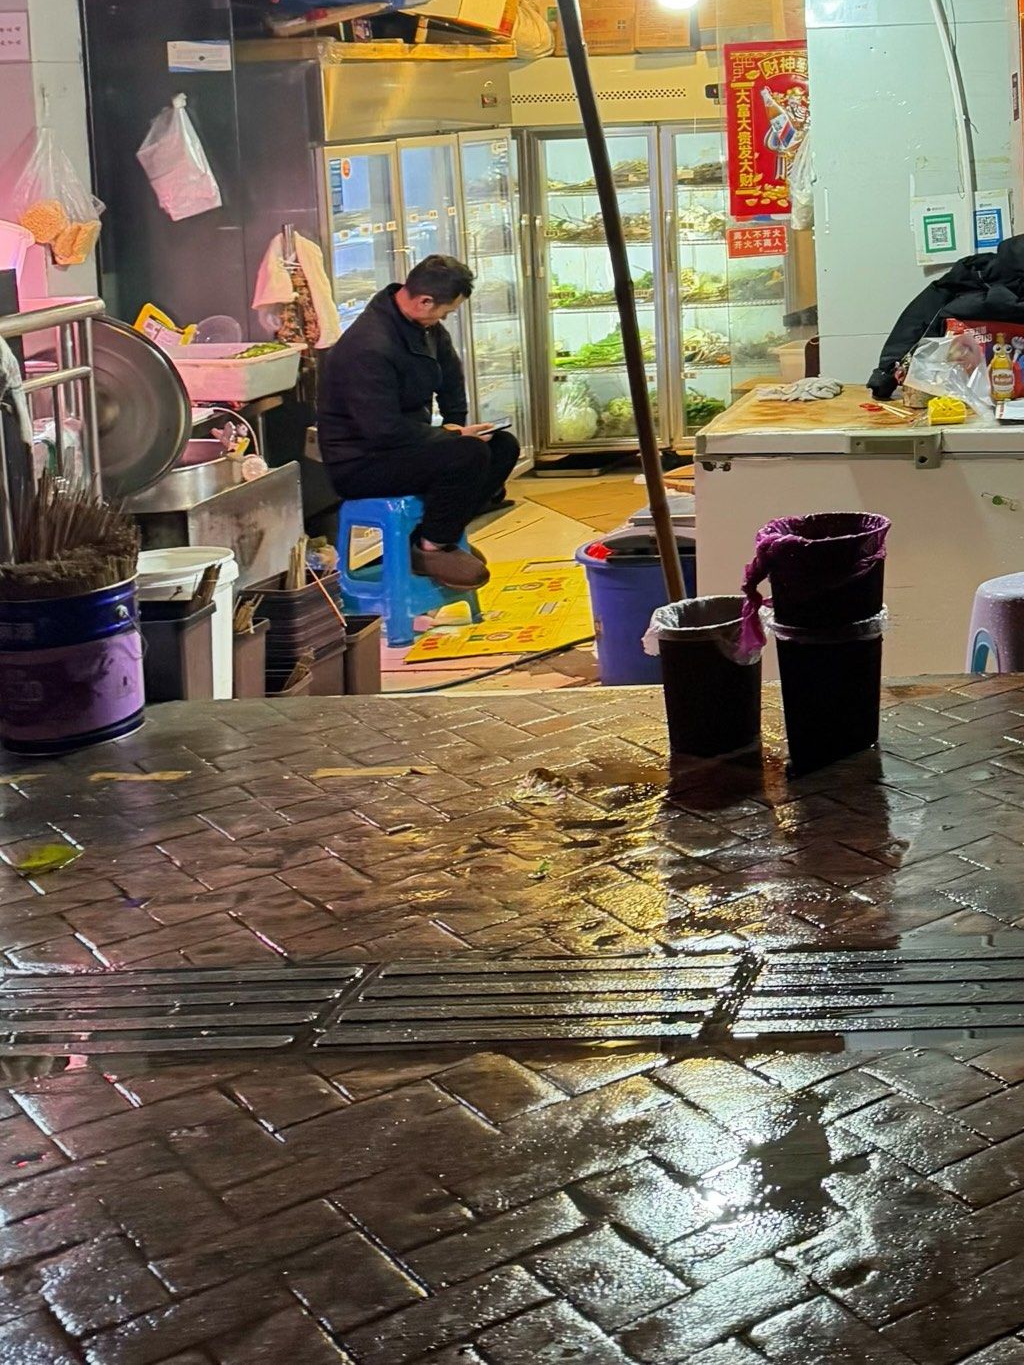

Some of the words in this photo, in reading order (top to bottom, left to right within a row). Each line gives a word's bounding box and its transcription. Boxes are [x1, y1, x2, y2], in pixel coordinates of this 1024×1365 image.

[736, 89, 753, 186] 大富大贵发大财
